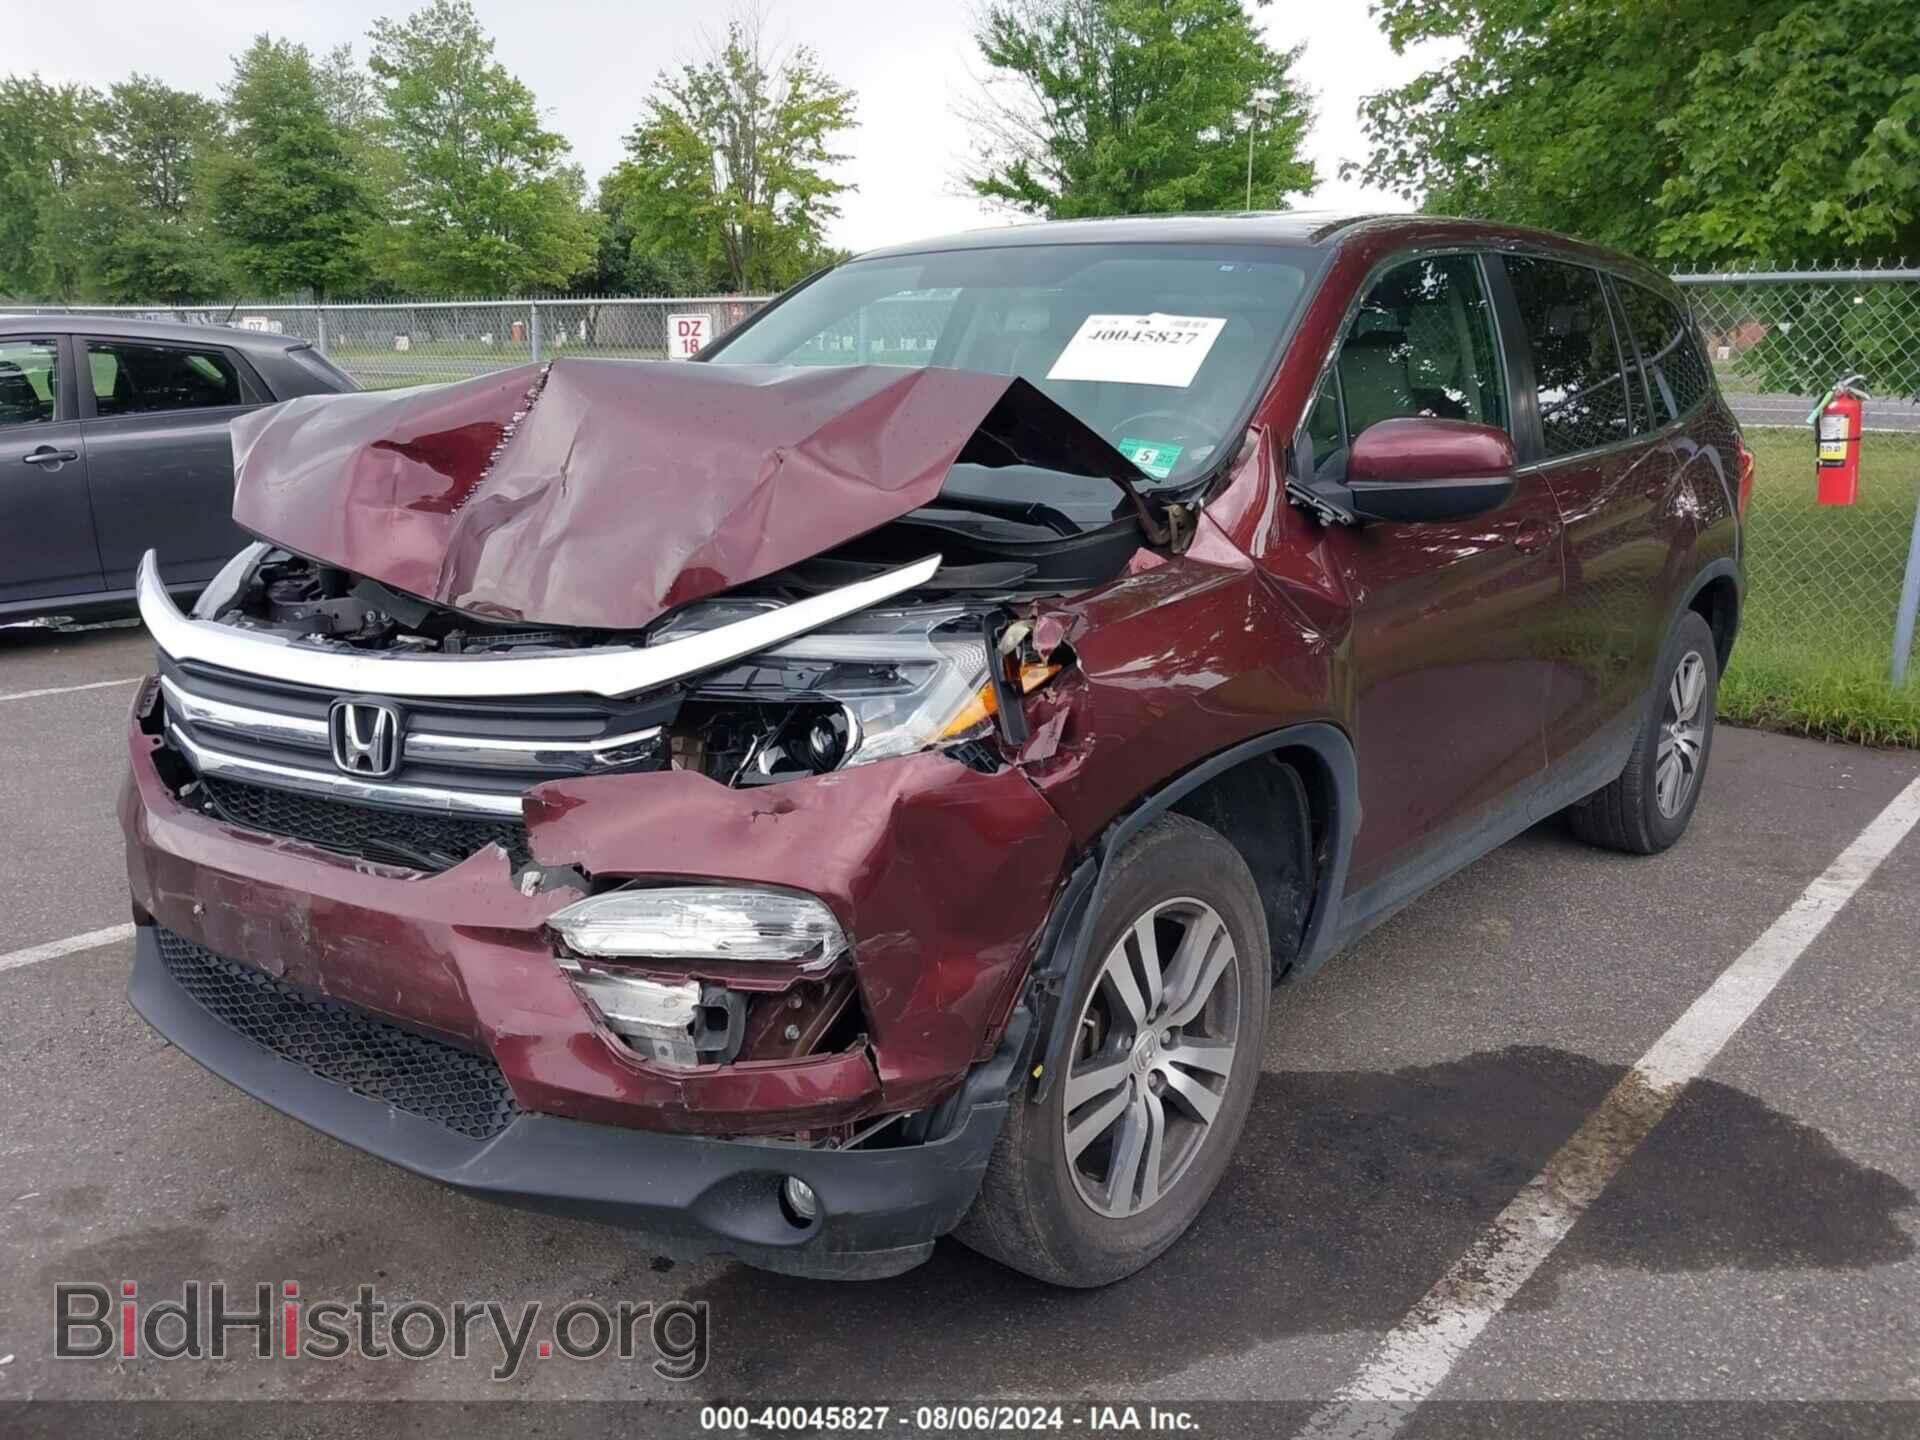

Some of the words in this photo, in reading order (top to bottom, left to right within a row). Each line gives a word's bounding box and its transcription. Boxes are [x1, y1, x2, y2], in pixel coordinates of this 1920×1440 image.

[678, 321, 702, 337] DZ
[1088, 329, 1199, 344] 40045827
[682, 339, 699, 354] 18
[1139, 450, 1152, 461] 5
